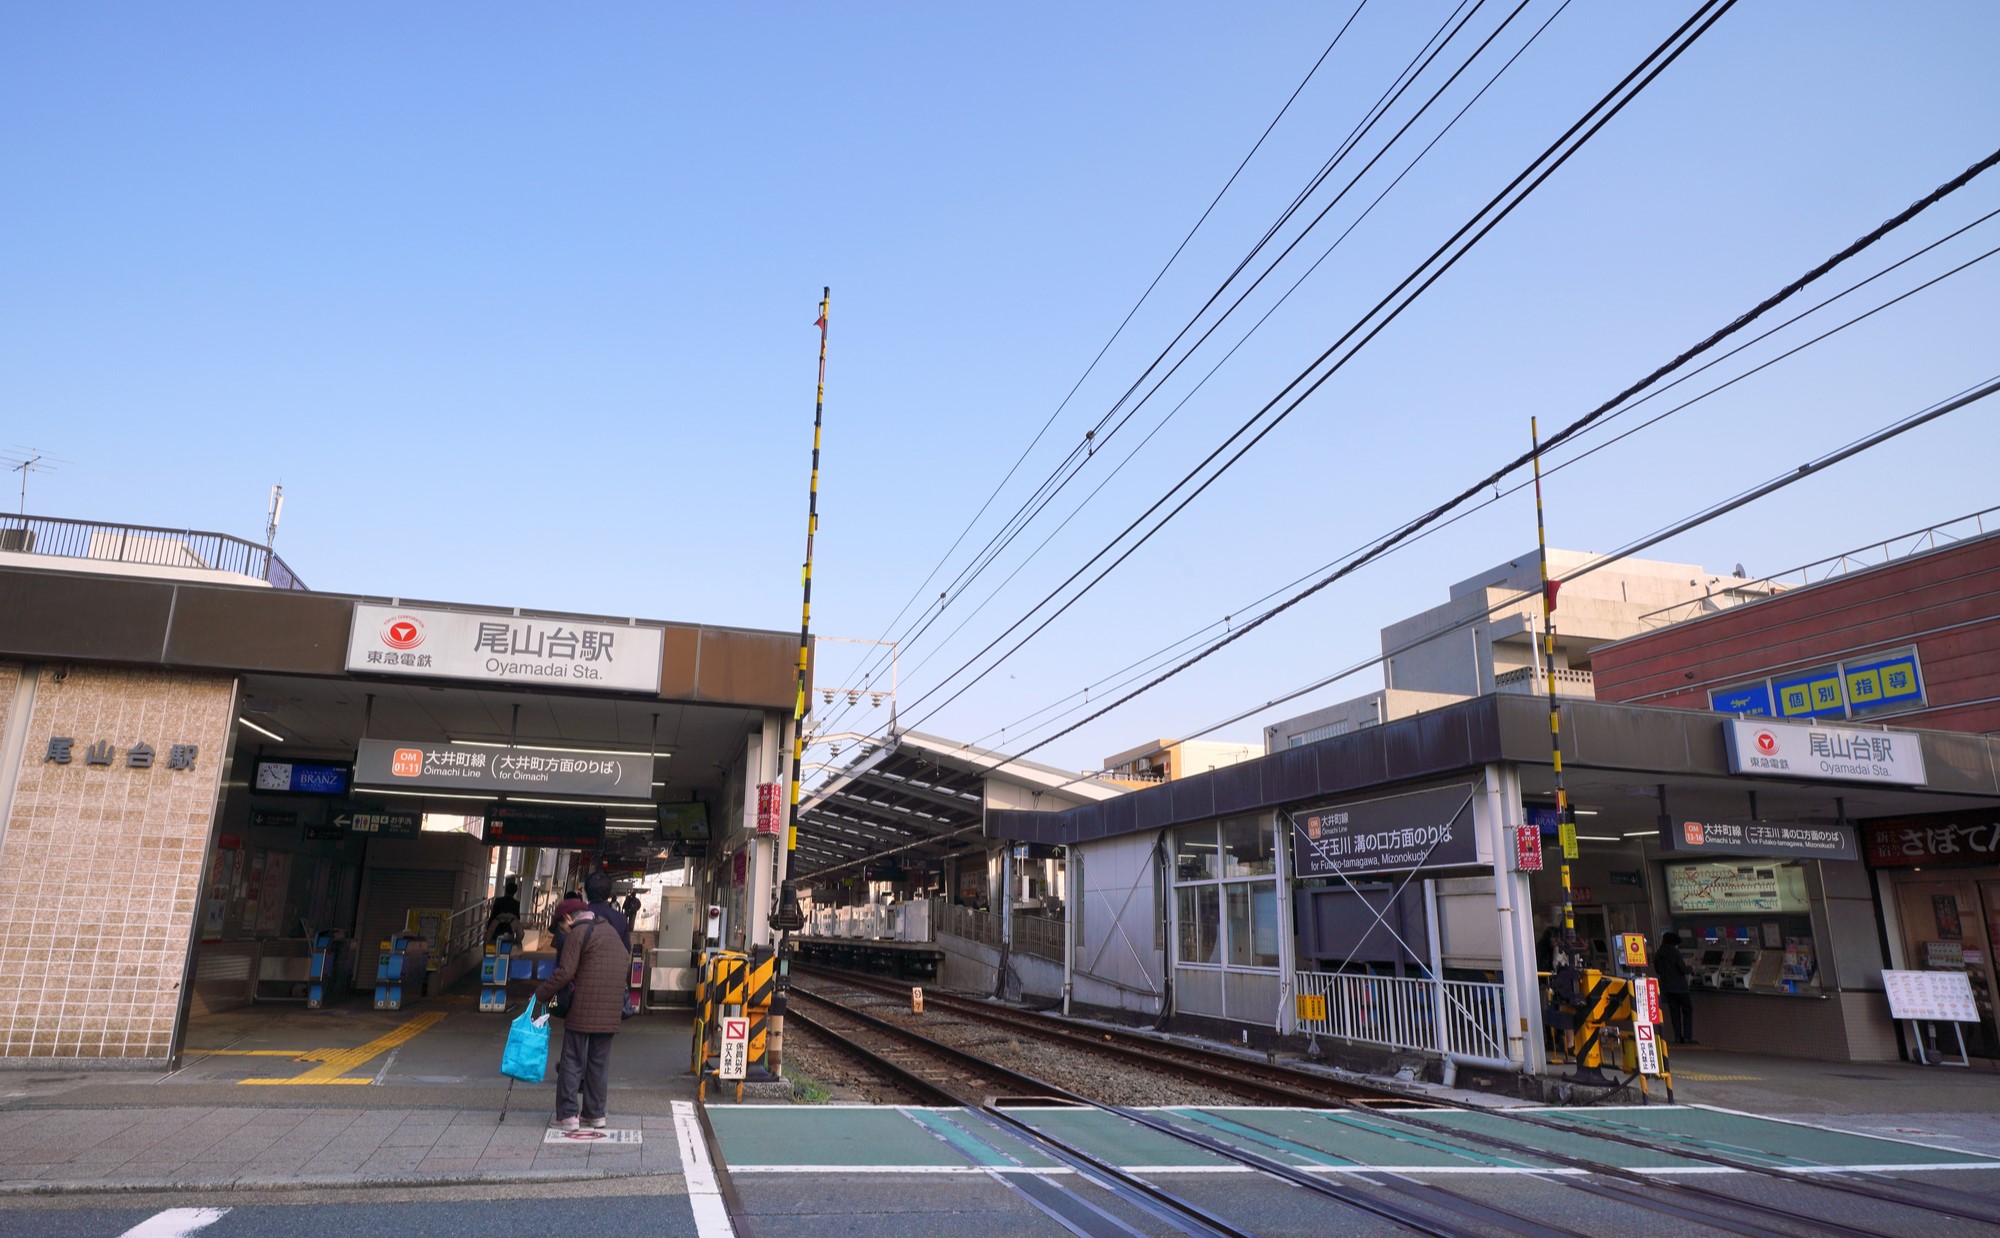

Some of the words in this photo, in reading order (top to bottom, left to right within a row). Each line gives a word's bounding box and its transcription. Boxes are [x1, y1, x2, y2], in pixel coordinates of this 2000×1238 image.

[473, 621, 614, 663] 尾山台駅
[367, 650, 432, 668] 東急電鉄
[485, 657, 568, 678] Oyamadai
[572, 664, 603, 680] Sta.
[1788, 671, 1908, 709] 個別指導
[43, 736, 199, 771] 尾山台駅
[400, 752, 417, 761] OM
[1808, 731, 1894, 763] 尾山台駅
[424, 750, 486, 767] 大井町線
[1749, 757, 1790, 770] 東急電鉄
[1819, 760, 1870, 776] Oyamadai
[1871, 764, 1892, 777] Sta.
[300, 774, 338, 785] BRANZ
[462, 768, 481, 778] Line
[499, 770, 511, 779] for
[1321, 812, 1349, 828] 大井町線
[1703, 823, 1742, 837] 大井町線
[1310, 835, 1351, 858] 二子玉川
[1354, 823, 1453, 853] 溝の口方面のりば
[1729, 837, 1741, 845] Line
[1804, 840, 1836, 849] Mizonokuchi
[1311, 860, 1320, 871] for
[1381, 849, 1428, 864] Mizonokuchi
[1648, 983, 1658, 1021] 非常ボタン
[724, 1042, 733, 1075] 立入禁止
[735, 1042, 744, 1075] 係員以外
[1640, 1042, 1649, 1070] 立入禁止
[1647, 1042, 1657, 1070] 係員以外
